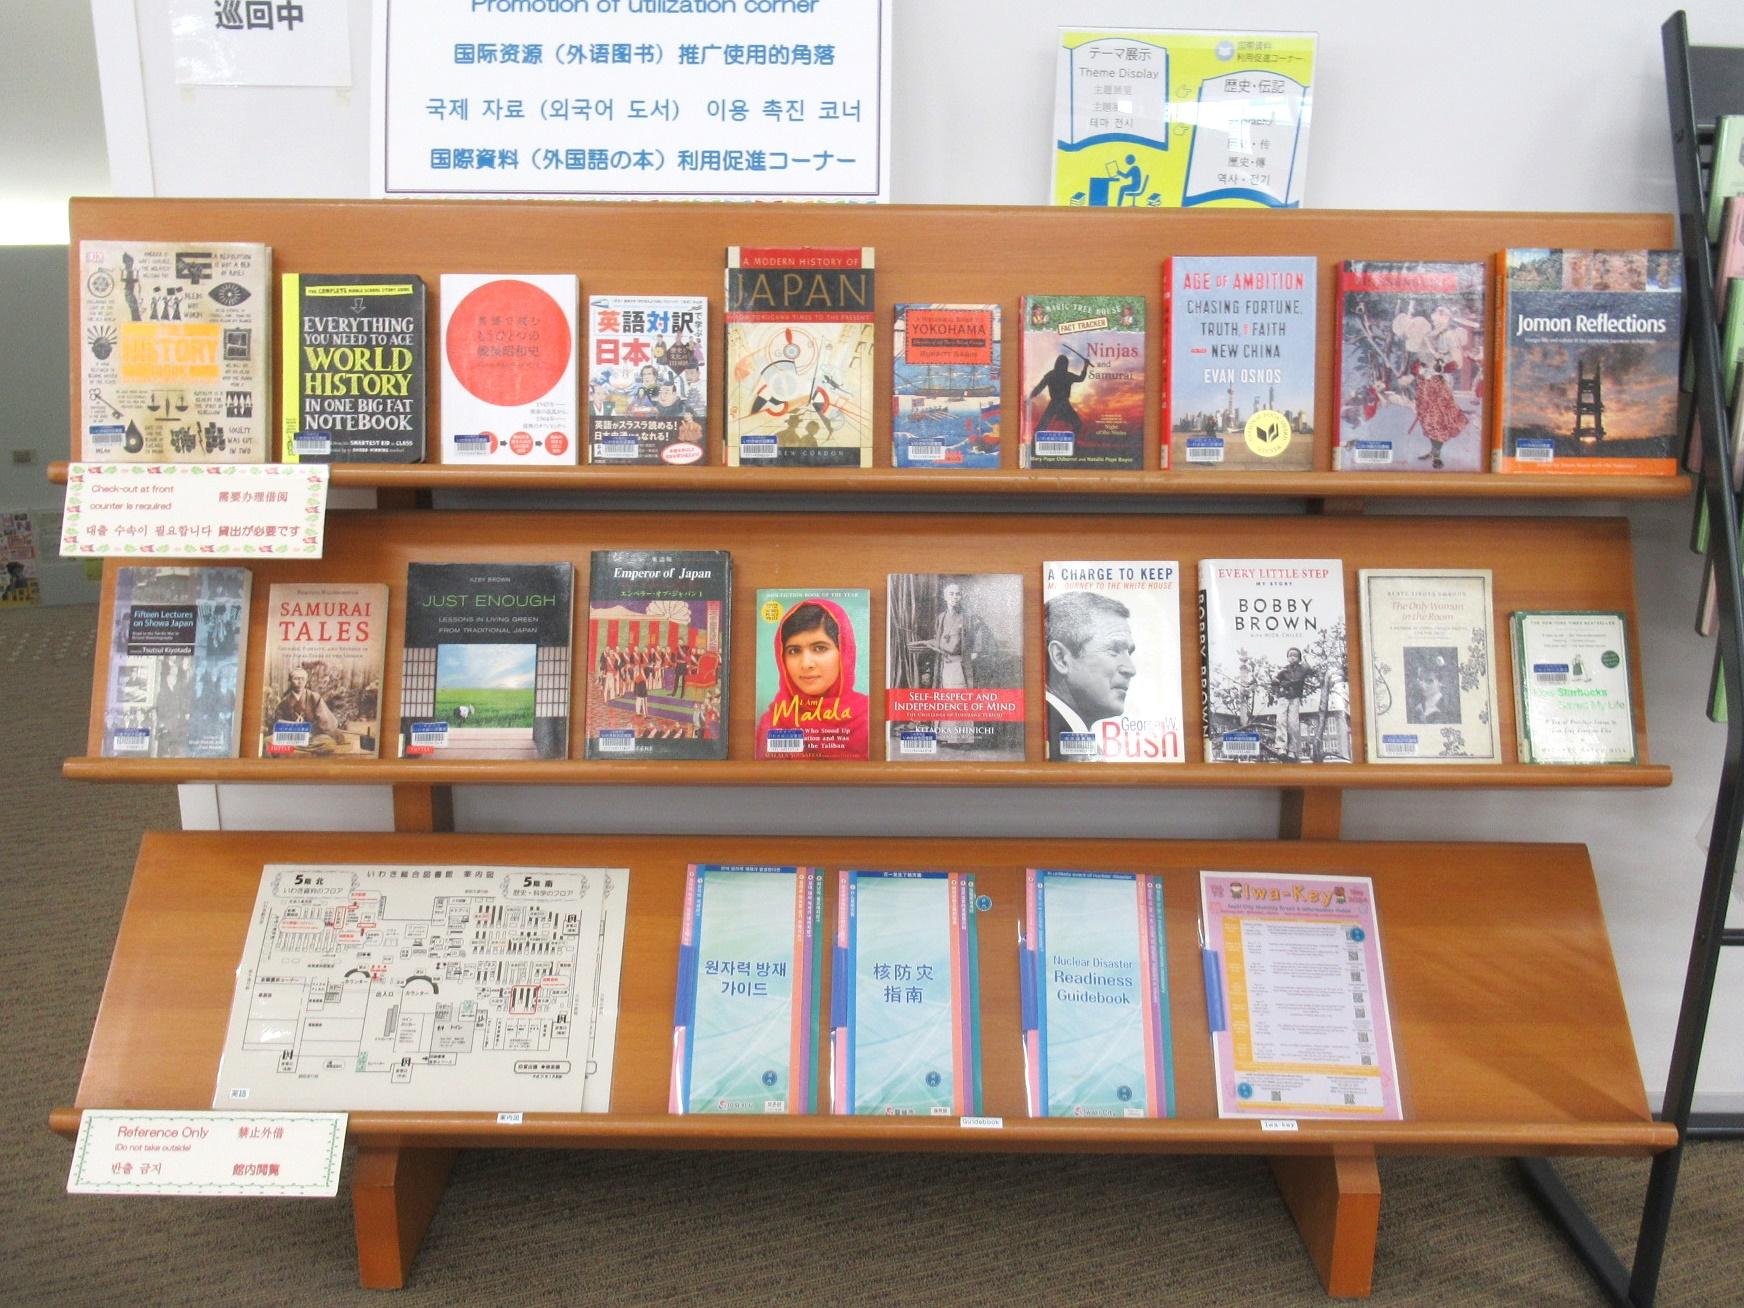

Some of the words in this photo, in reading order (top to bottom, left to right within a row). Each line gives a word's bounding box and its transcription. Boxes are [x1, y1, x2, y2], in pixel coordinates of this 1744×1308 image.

[472, 0, 588, 13] Promotion
[597, 0, 620, 13] of
[744, 0, 820, 13] corner
[214, 0, 304, 30] 巡回中
[1090, 47, 1152, 61] テーマ展示
[1079, 67, 1116, 78] Theme
[1118, 69, 1159, 81] Display
[1224, 79, 1286, 94] 歴史・伝記
[425, 98, 469, 121] 국제
[482, 98, 525, 121] 자료
[540, 98, 614, 121] (외국어
[627, 98, 680, 122] 도서)
[707, 98, 750, 122] 이용
[762, 99, 805, 122] 촉진
[818, 99, 862, 122] 코너
[430, 148, 857, 171] 国際資料（外国語の本）利用促進コーナー
[1184, 272, 1210, 290] AGE
[1216, 275, 1228, 287] OF
[1233, 272, 1305, 290] AMBITION
[735, 274, 866, 307] JAPAN
[1187, 300, 1239, 314] CHASING
[1246, 300, 1302, 315] FORTUNE,
[303, 317, 414, 333] EVERYTHING
[597, 310, 694, 334] 英語対訳
[912, 324, 986, 335] YOKOHAMA
[1061, 323, 1076, 332] FACT
[1077, 320, 1106, 330] TRACKER
[1252, 322, 1286, 336] FAITH
[1516, 314, 1571, 336] Jomon
[1576, 313, 1666, 333] Reflections
[304, 334, 329, 345] YOU
[333, 334, 366, 345] NEED
[370, 334, 387, 345] TO
[390, 334, 414, 345] ACE
[595, 338, 650, 366] 日本
[1087, 343, 1138, 358] Ninjas
[1211, 344, 1240, 358] NEW
[1244, 344, 1280, 358] CHINA
[304, 347, 413, 372] WORLD
[1088, 369, 1133, 380] Samurai
[1204, 369, 1234, 384] EVAN
[1241, 369, 1281, 384] OSNOS
[304, 372, 413, 396] HISTORY
[305, 399, 320, 412] IN
[325, 399, 354, 412] ONE
[358, 399, 382, 412] BIG
[387, 400, 413, 412] FAT
[304, 414, 413, 430] NOTEBOOK
[91, 485, 138, 493] Check-out
[140, 485, 150, 493] at
[152, 485, 174, 493] front
[135, 502, 172, 511] required
[155, 525, 212, 537] 필요합니다
[614, 567, 661, 580] Emperor
[663, 568, 674, 578] of
[679, 568, 712, 580] Japan
[1048, 568, 1055, 580] A
[1061, 568, 1112, 581] CHARGE
[1120, 568, 1134, 580] TO
[1141, 568, 1173, 581] KEEP
[1218, 569, 1255, 578] EVERY
[1259, 569, 1299, 578] LITTLE
[1302, 569, 1329, 579] STEP
[422, 595, 469, 607] JUST
[475, 595, 556, 607] ENOUGH
[1239, 598, 1313, 613] BOBBY
[280, 602, 372, 617] SAMURAI
[145, 619, 170, 627] Showa
[171, 619, 193, 628] Japan
[1235, 617, 1317, 631] BROWN
[279, 621, 369, 642] TALES
[1558, 687, 1608, 697] Starbucks
[773, 695, 852, 727] Malala
[1102, 721, 1178, 758] Bush
[705, 959, 751, 977] 원자력
[756, 960, 787, 977] 방재
[1053, 955, 1089, 966] Nuclear
[1093, 956, 1132, 969] Disaster
[873, 963, 934, 981] 核防灾
[1054, 970, 1133, 987] Readiness
[721, 981, 769, 997] 가이드
[884, 985, 924, 1004] 指南
[1057, 989, 1130, 1005] Guidebook
[117, 1126, 178, 1138] Reference
[182, 1127, 209, 1140] Only
[238, 1126, 285, 1139] 禁止外借
[130, 1144, 142, 1152] not
[144, 1143, 159, 1152] take
